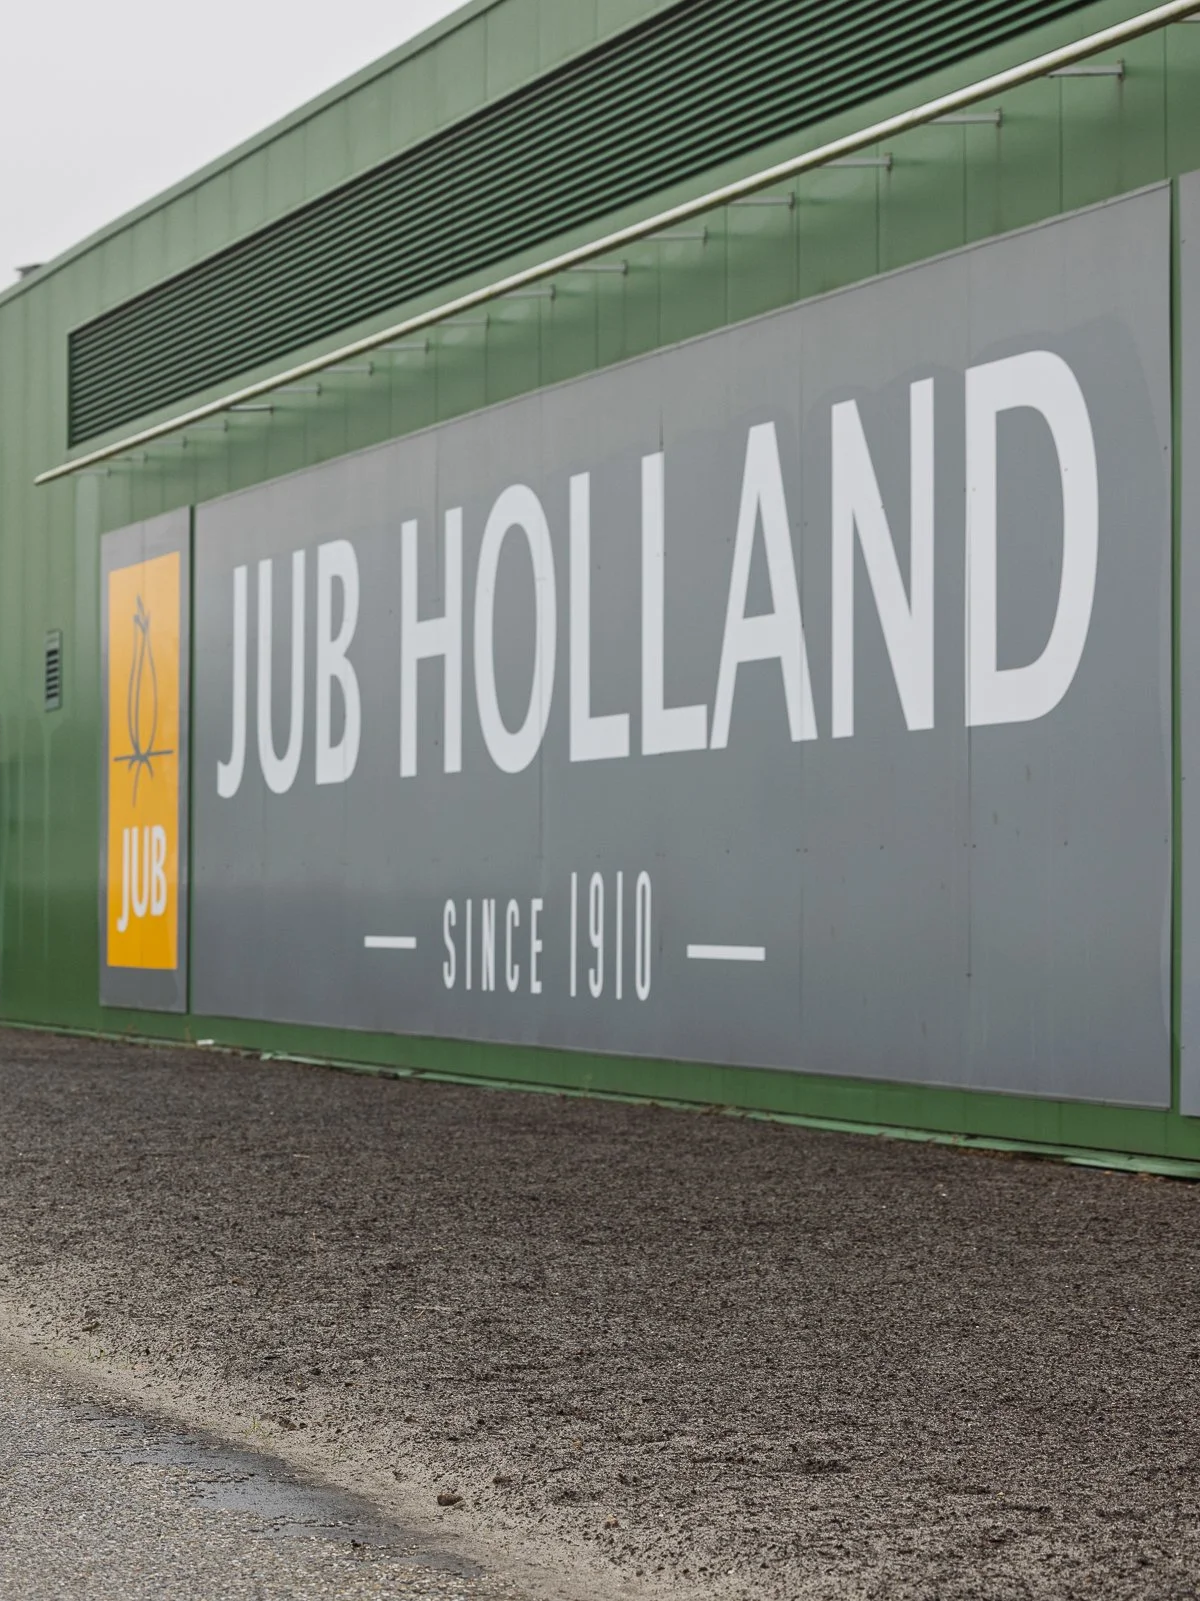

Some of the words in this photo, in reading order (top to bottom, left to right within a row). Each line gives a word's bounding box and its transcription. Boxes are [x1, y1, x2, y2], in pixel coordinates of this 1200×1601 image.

[216, 538, 362, 799] JUB
[400, 349, 1100, 778] HOLLAND
[116, 824, 168, 933] JUB
[442, 898, 545, 994] SINCE
[569, 870, 653, 1001] 1910
